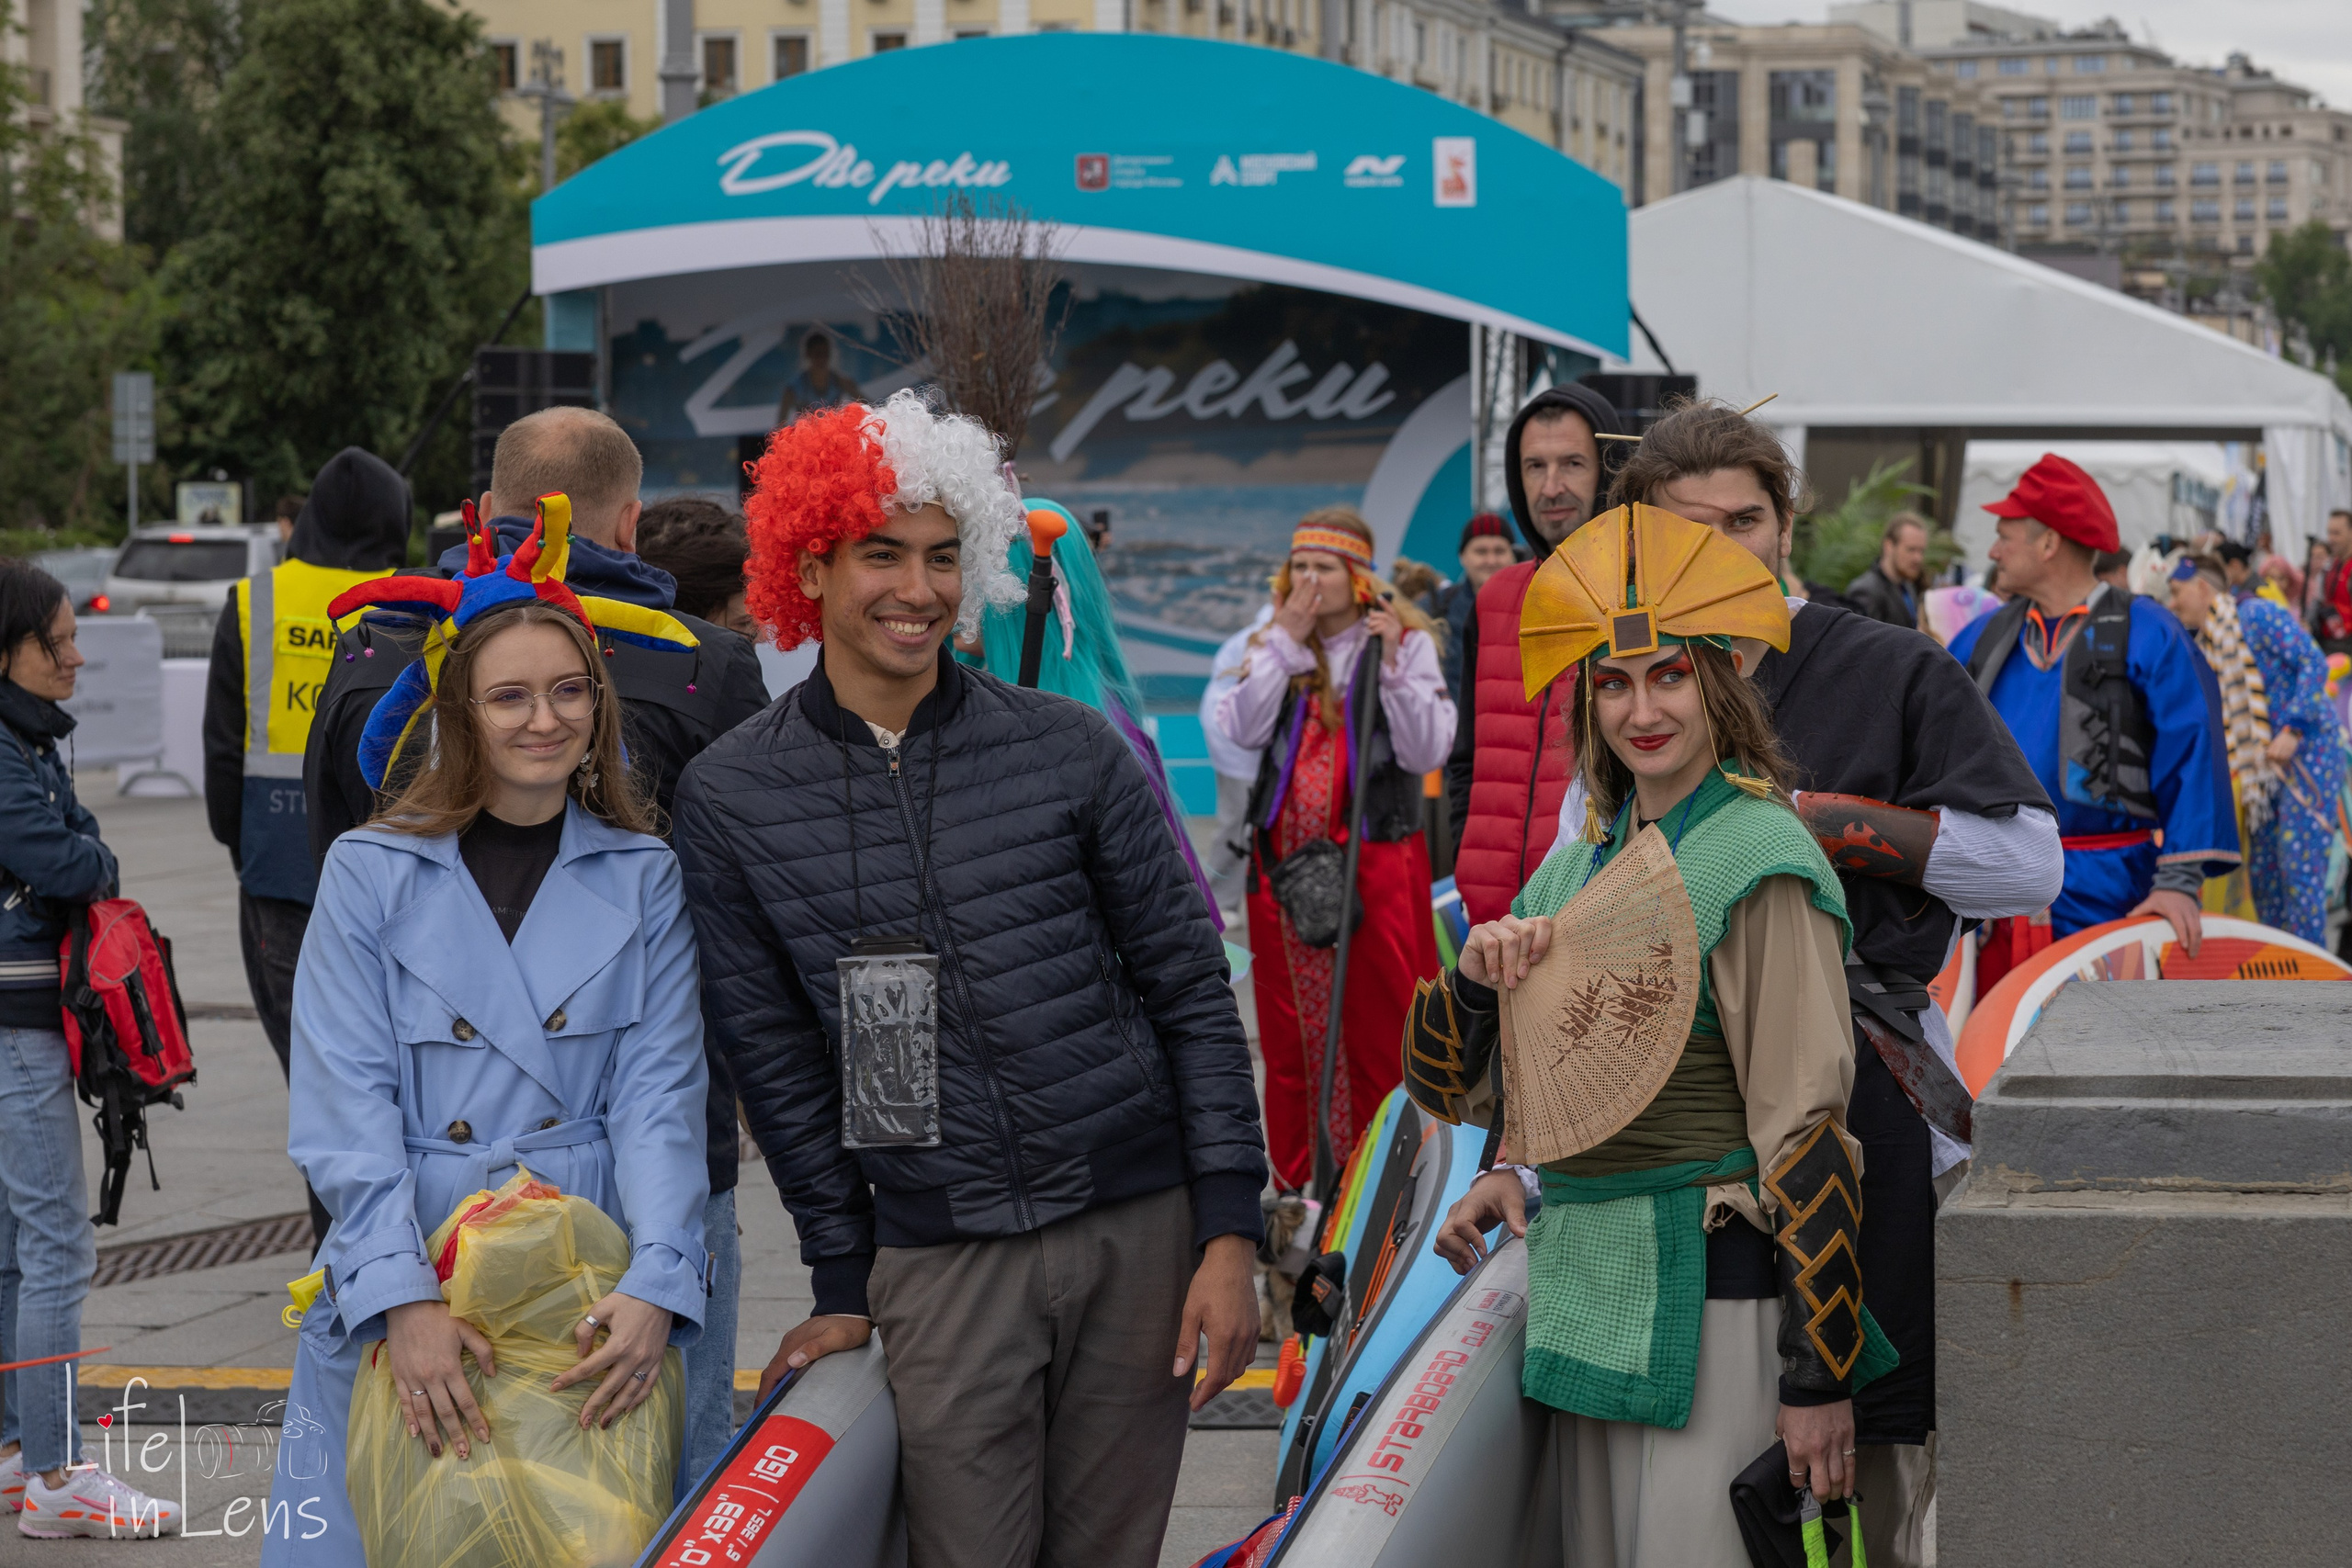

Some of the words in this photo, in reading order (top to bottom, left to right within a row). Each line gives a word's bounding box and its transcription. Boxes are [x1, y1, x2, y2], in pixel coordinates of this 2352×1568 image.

[717, 129, 876, 197] Две
[867, 150, 1013, 207] реки
[1461, 1320, 1495, 1348] CLUB
[741, 1514, 765, 1541] 365
